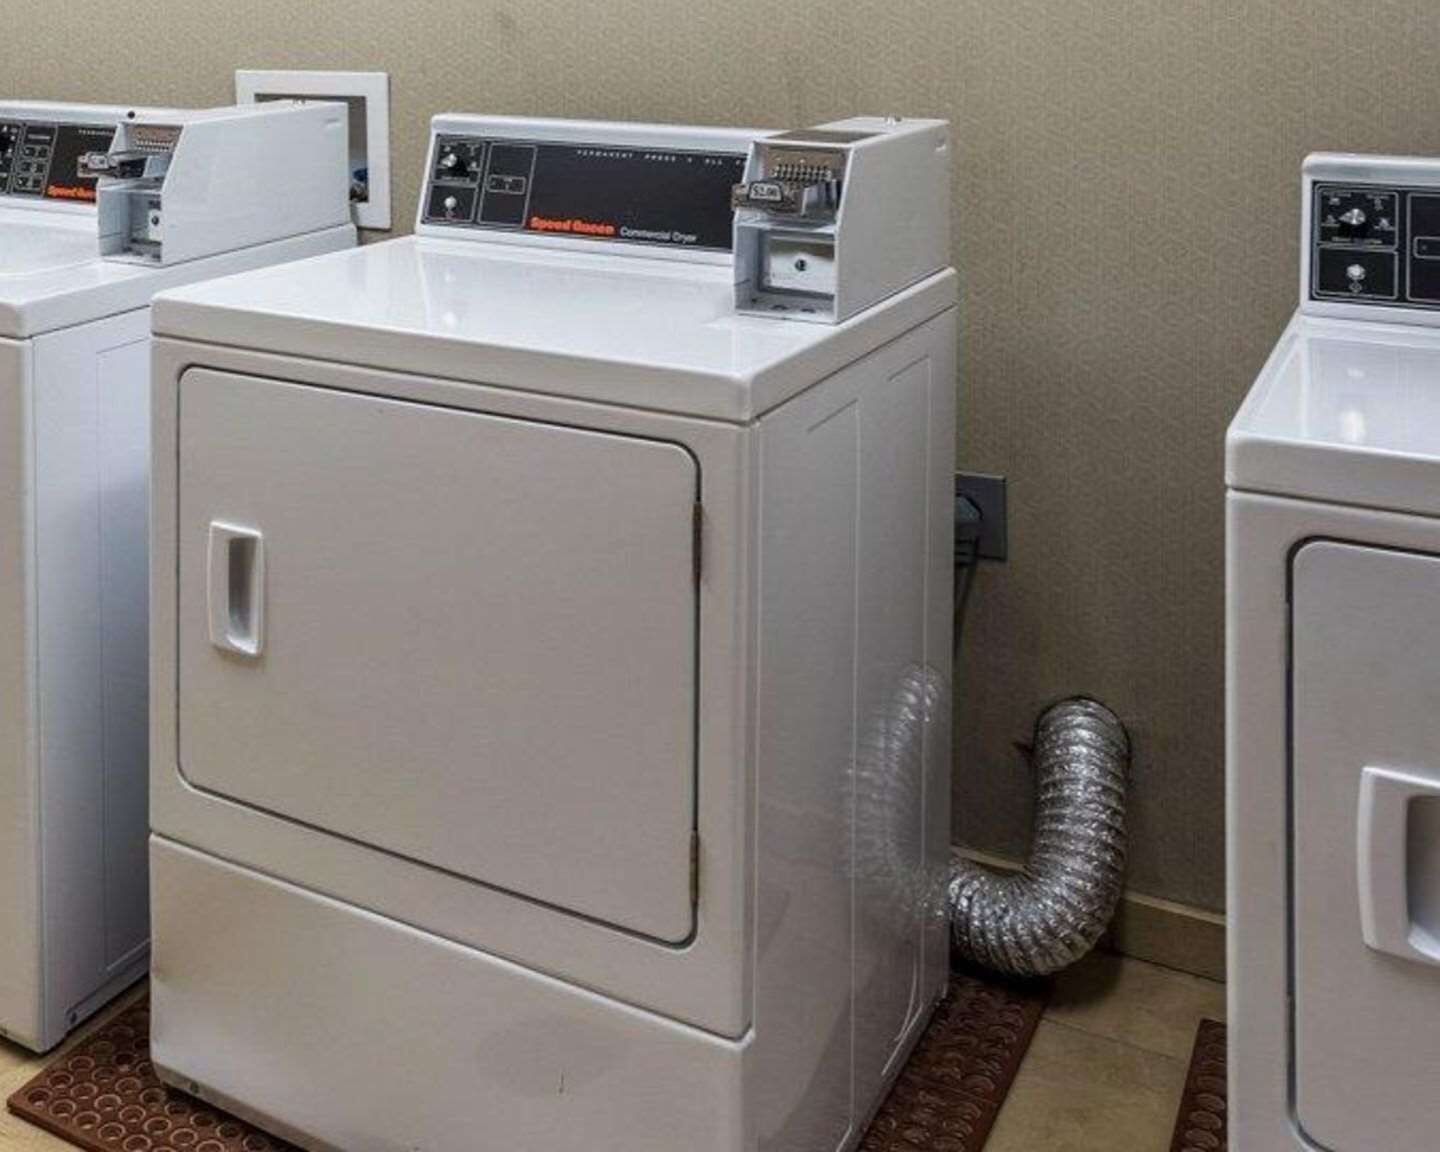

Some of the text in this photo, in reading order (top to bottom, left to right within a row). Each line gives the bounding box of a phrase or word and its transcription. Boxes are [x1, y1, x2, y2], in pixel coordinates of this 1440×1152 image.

[530, 216, 697, 243] Speed Queen Commercial Dryer
